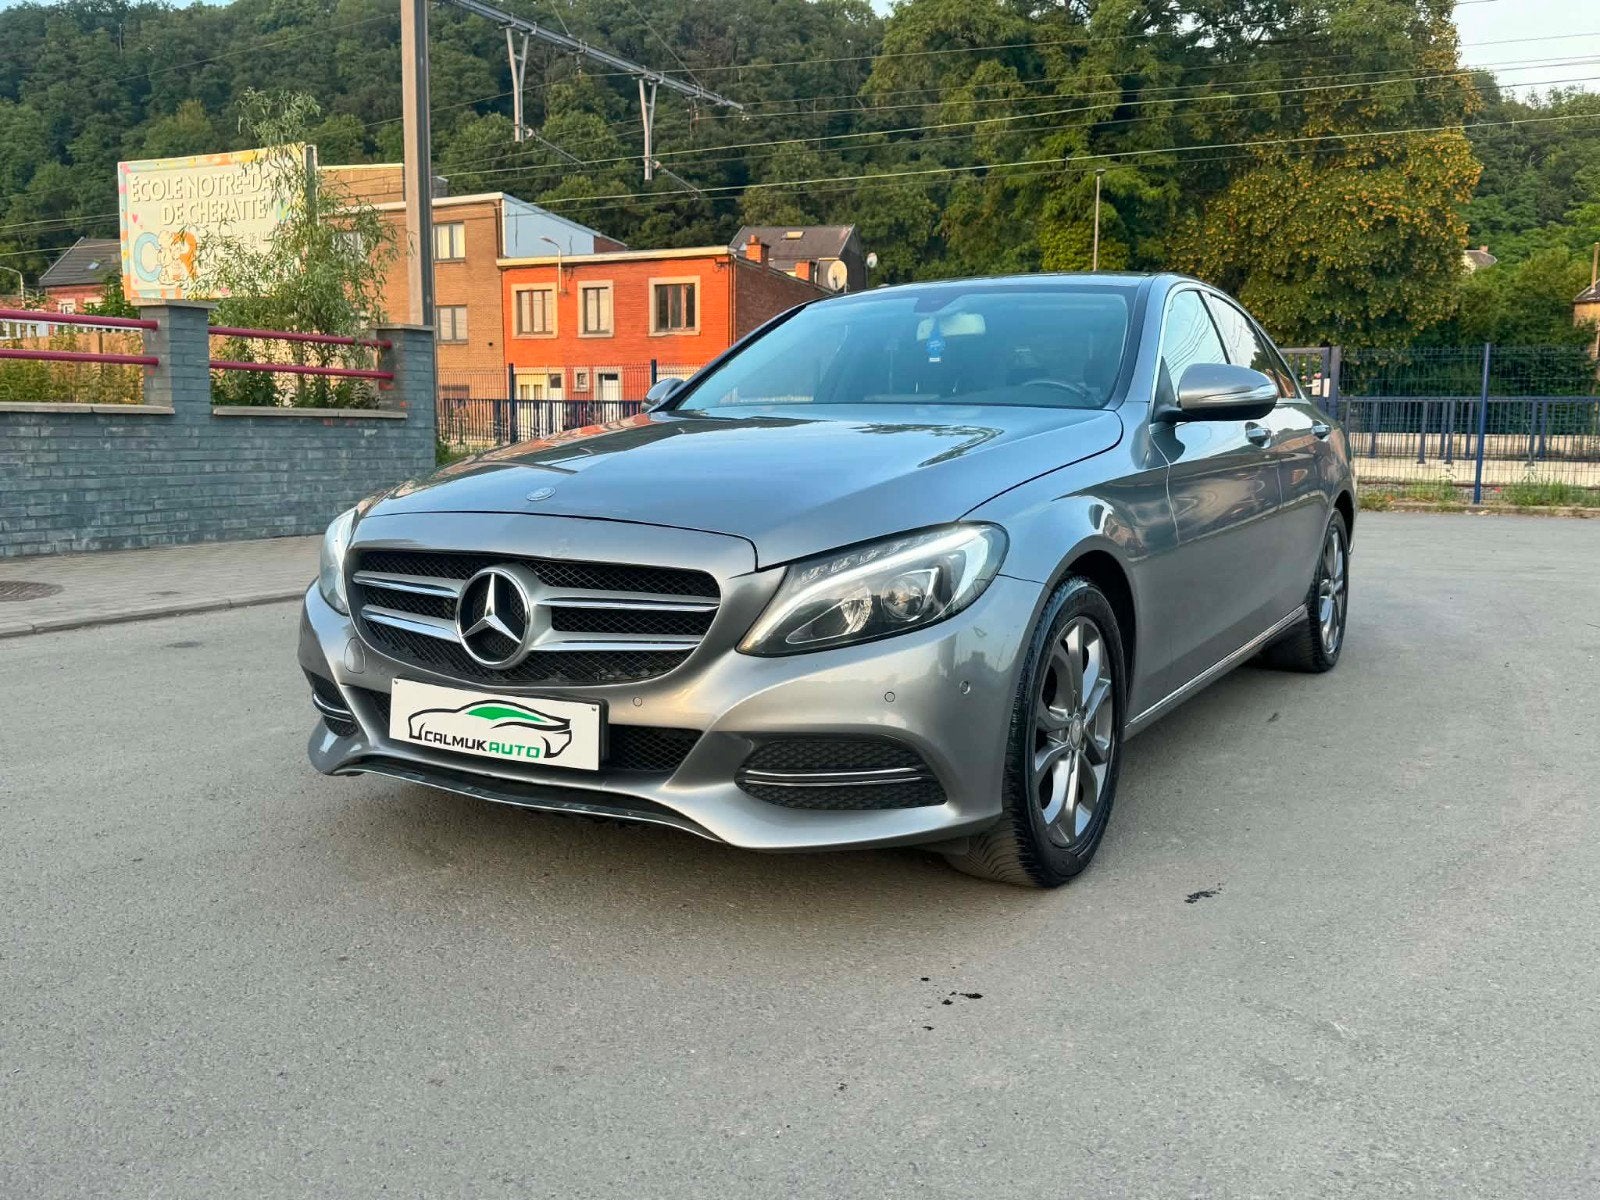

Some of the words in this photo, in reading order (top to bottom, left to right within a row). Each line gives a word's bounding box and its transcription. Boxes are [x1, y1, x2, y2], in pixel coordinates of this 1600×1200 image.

[130, 175, 184, 202] ÉCOLE
[162, 203, 185, 226] DE
[188, 196, 269, 224] CHERATTE
